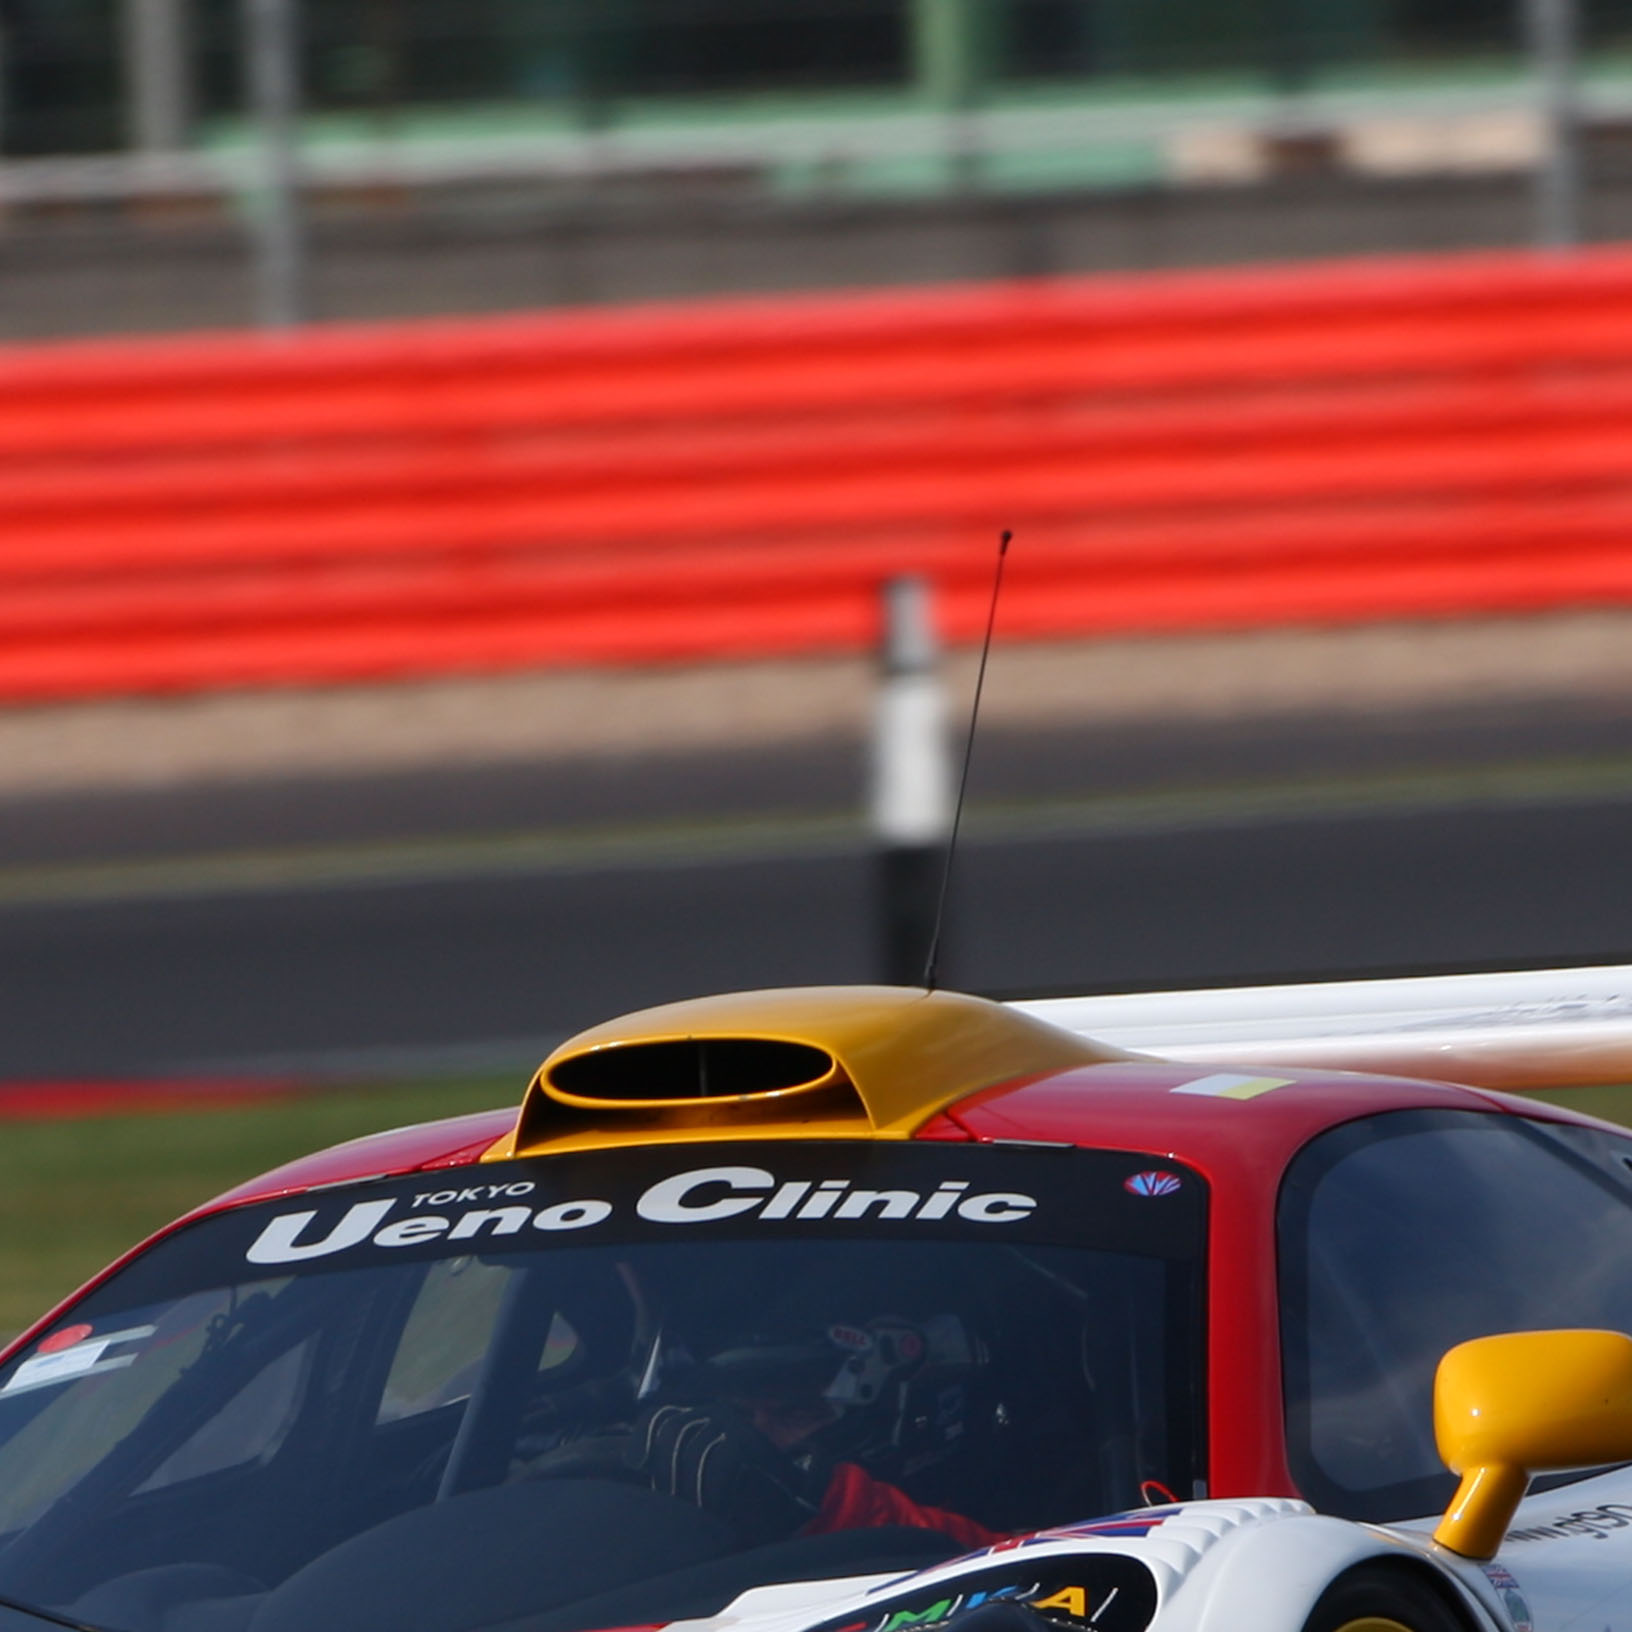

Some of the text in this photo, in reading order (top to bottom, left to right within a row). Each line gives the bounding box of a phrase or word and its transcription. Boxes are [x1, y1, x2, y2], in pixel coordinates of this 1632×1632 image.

[245, 1166, 1037, 1265] Ueno Clinic
[413, 1180, 536, 1209] TOKYO
